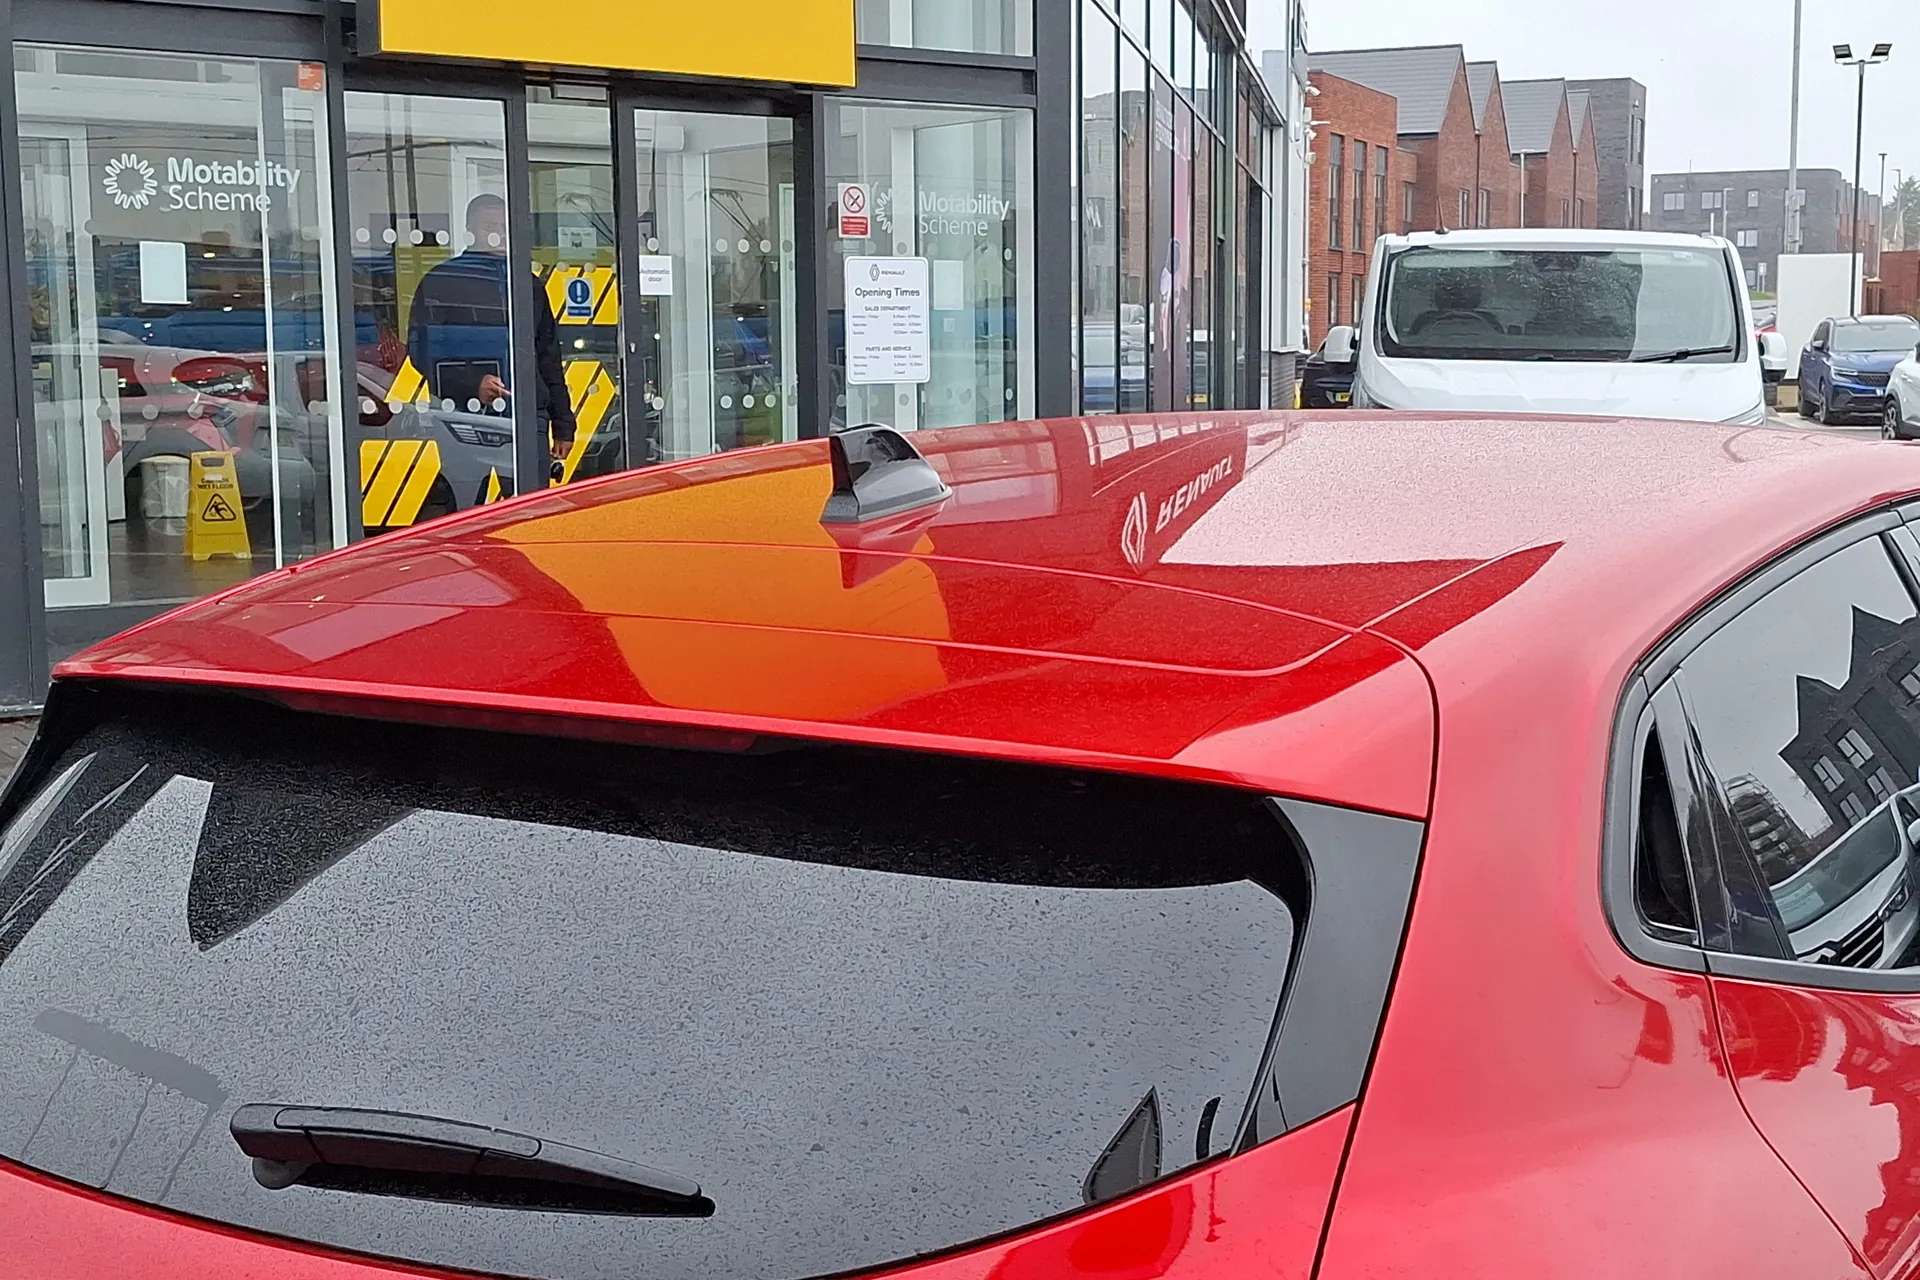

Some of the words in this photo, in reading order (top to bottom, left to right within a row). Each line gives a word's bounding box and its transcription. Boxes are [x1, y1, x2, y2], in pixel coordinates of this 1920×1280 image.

[167, 157, 300, 193] Motability
[168, 184, 272, 212] Scheme
[919, 190, 1010, 221] Motability
[919, 214, 988, 236] Scheme
[855, 287, 892, 299] Opening
[894, 287, 920, 297] Times
